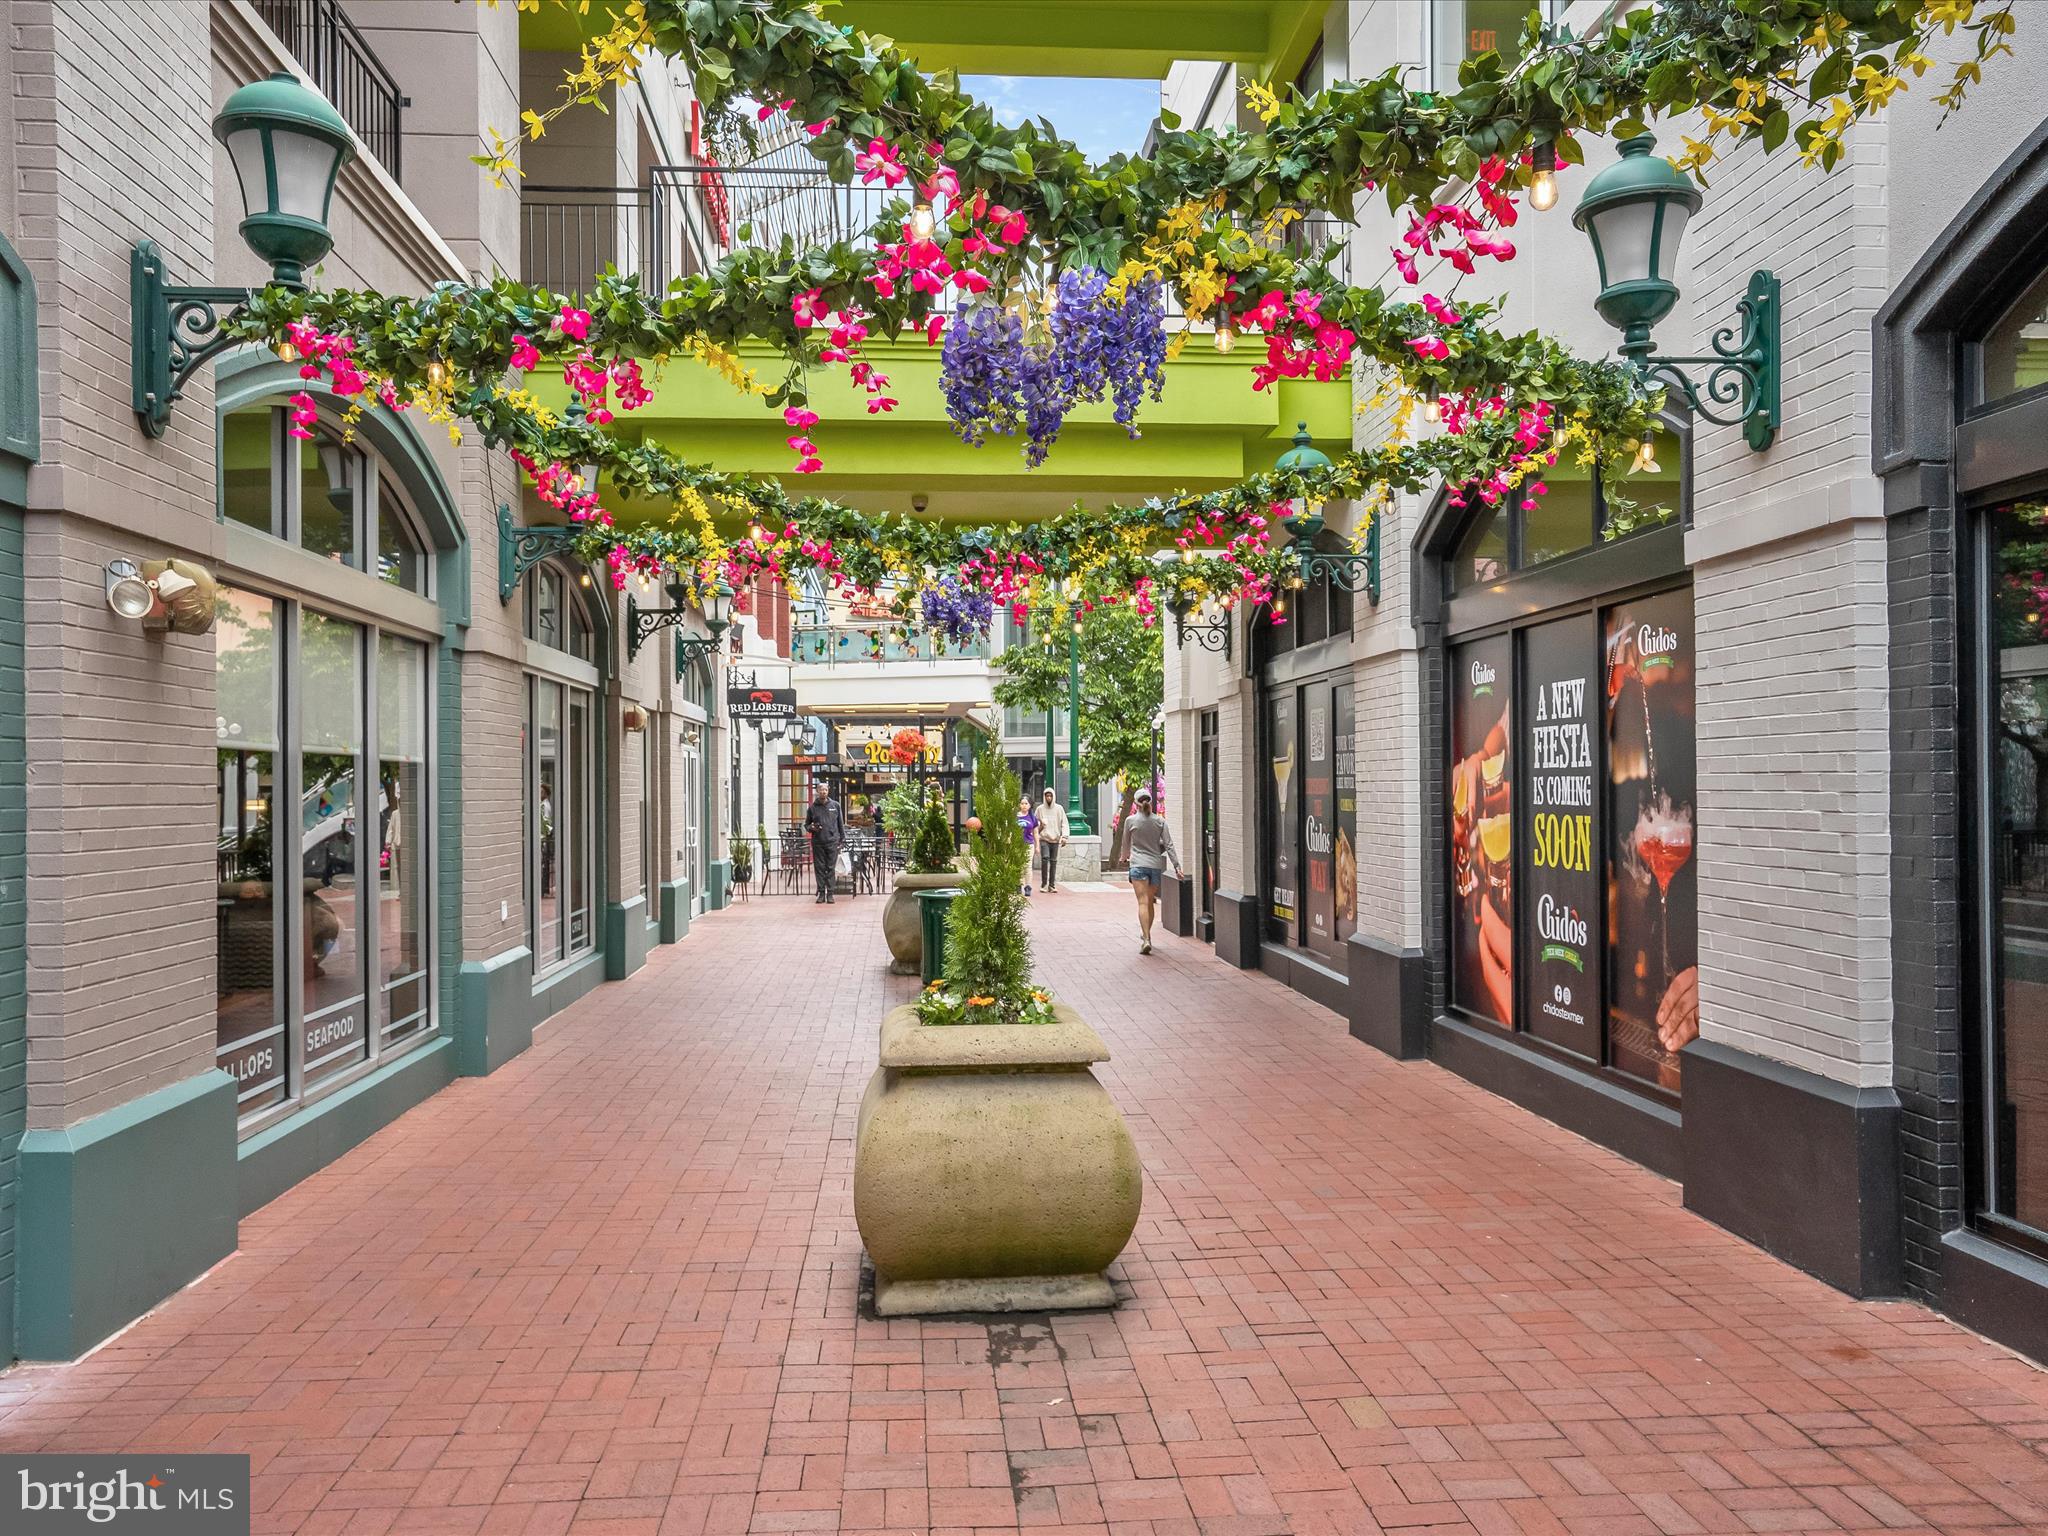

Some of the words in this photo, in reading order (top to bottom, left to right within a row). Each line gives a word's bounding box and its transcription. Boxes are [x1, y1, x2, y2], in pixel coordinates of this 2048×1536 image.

[1471, 29, 1496, 51] EXIT
[1638, 624, 1677, 656] Chidos
[1471, 661, 1496, 686] Chidos
[730, 703, 751, 714] RED
[752, 702, 795, 714] LOBSTER
[1536, 684, 1547, 721] A
[1551, 678, 1585, 720] NEW
[1533, 723, 1592, 769] FIESTA
[1533, 776, 1544, 806] IS
[1546, 776, 1591, 807] COMING
[1306, 815, 1330, 853] Chidos
[1534, 813, 1591, 872] SOON
[1537, 893, 1588, 947] Chidos
[306, 1015, 354, 1052] SEAFOOD
